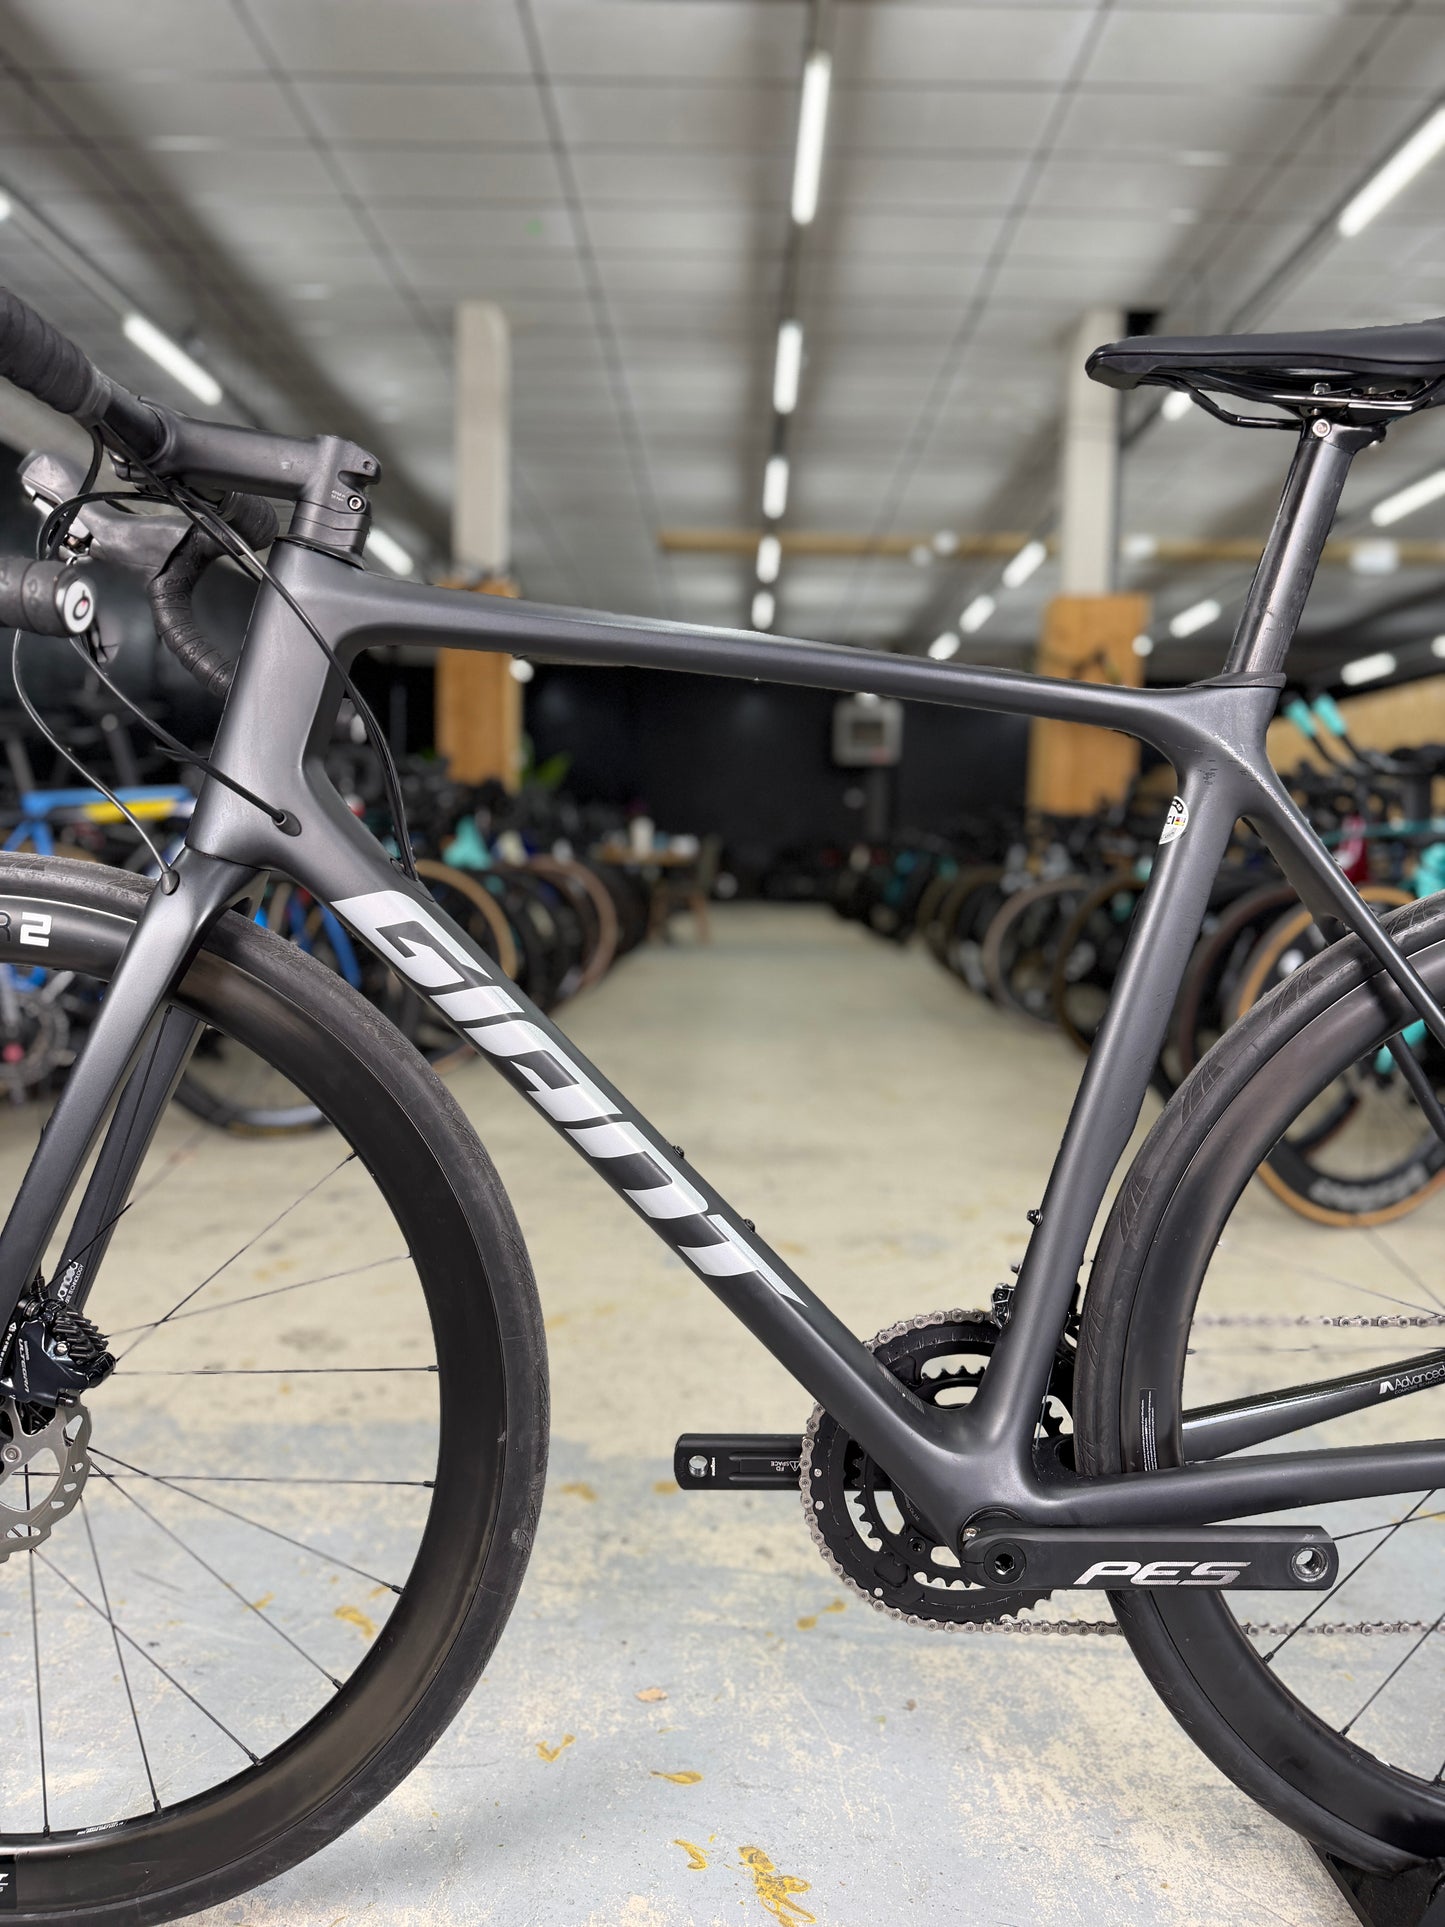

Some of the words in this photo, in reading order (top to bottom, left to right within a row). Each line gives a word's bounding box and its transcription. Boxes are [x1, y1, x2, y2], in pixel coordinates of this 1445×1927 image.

[330, 889, 809, 1308] GIANT
[18, 1338, 31, 1393] ULTEGRA
[1394, 1364, 1445, 1391] Advanced
[1073, 1561, 1252, 1585] PES
